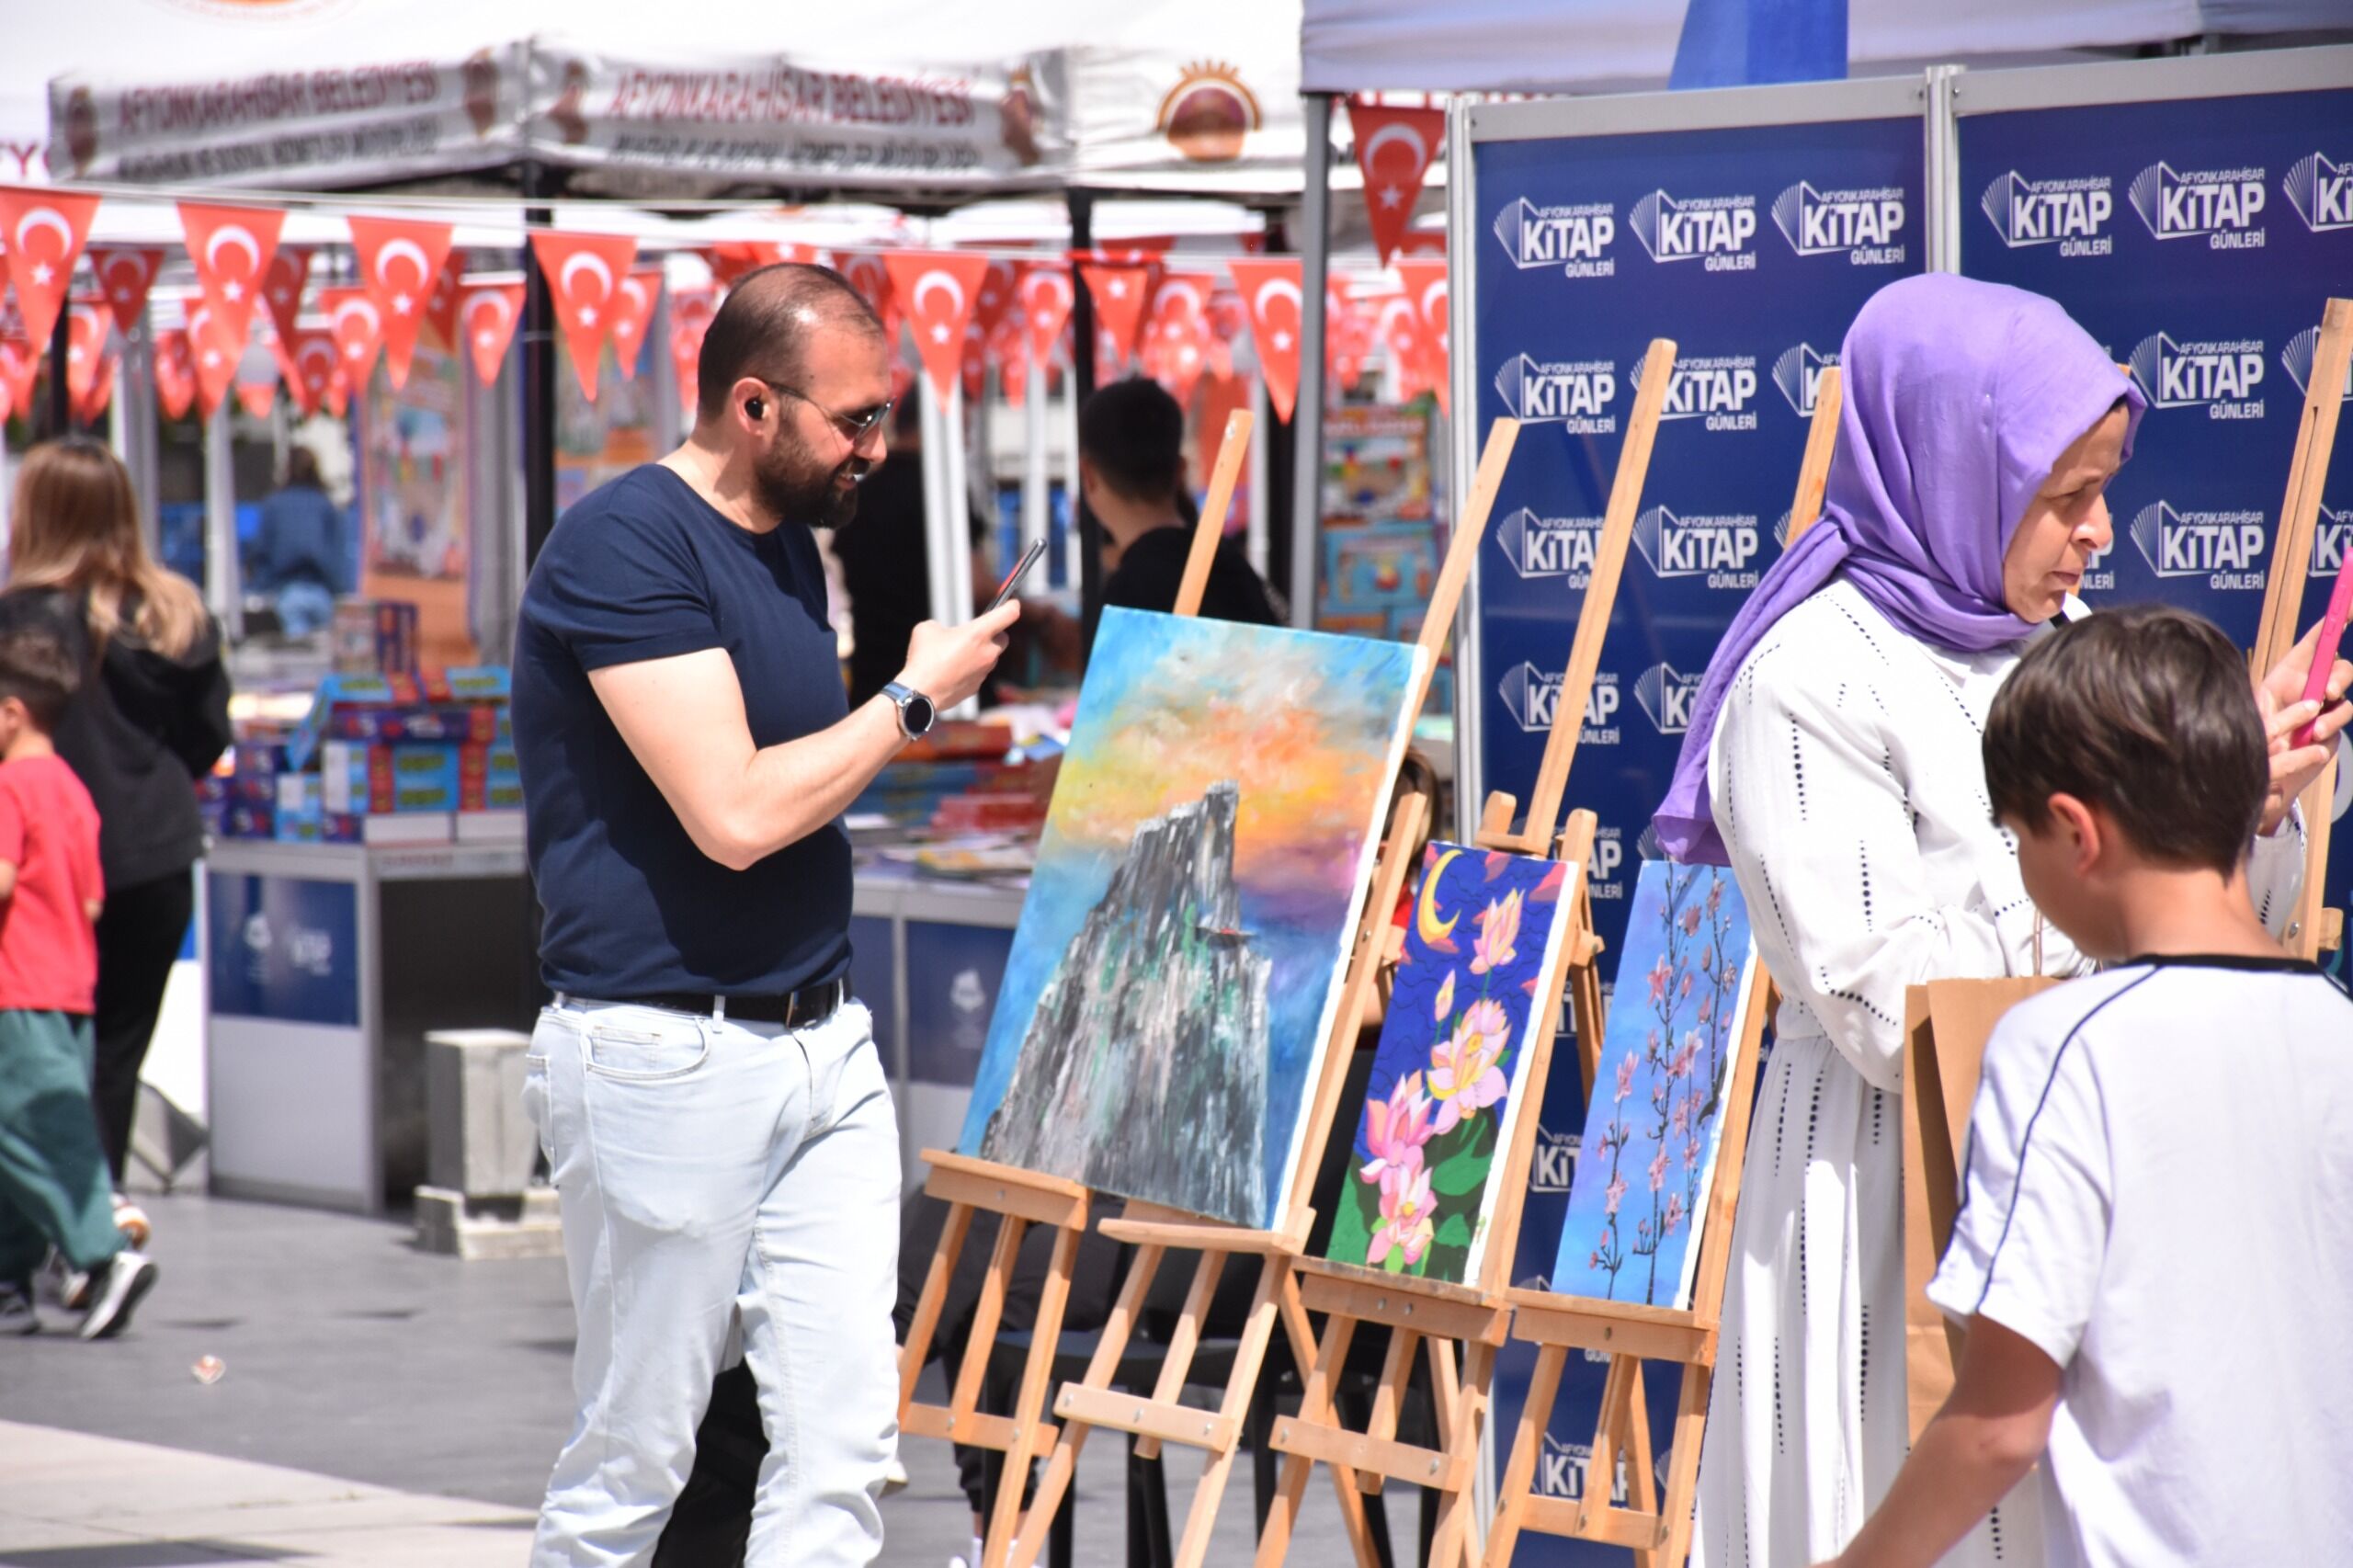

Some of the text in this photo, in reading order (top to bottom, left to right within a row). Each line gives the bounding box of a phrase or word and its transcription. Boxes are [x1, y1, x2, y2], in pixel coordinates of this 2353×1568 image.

[2061, 233, 2112, 257] GÜNLERİ
[2211, 228, 2264, 249] GÜNLERİ
[1705, 252, 1756, 270] GÜNLERİ
[1851, 245, 1904, 264] GÜNLERİ
[1565, 259, 1614, 277] GÜNLERİ
[2210, 399, 2263, 419] GÜNLERİ
[1567, 415, 1615, 434] GÜNLERİ
[1706, 411, 1756, 429] GÜNLERİ
[1527, 529, 1603, 570] KİTA
[1708, 571, 1758, 588] GÜNLERİ
[2080, 572, 2114, 589] NLERİ
[2211, 571, 2264, 589] GÜNLERİ
[1579, 726, 1620, 744] ÜNLERİ
[1589, 881, 1623, 899] NLERİ
